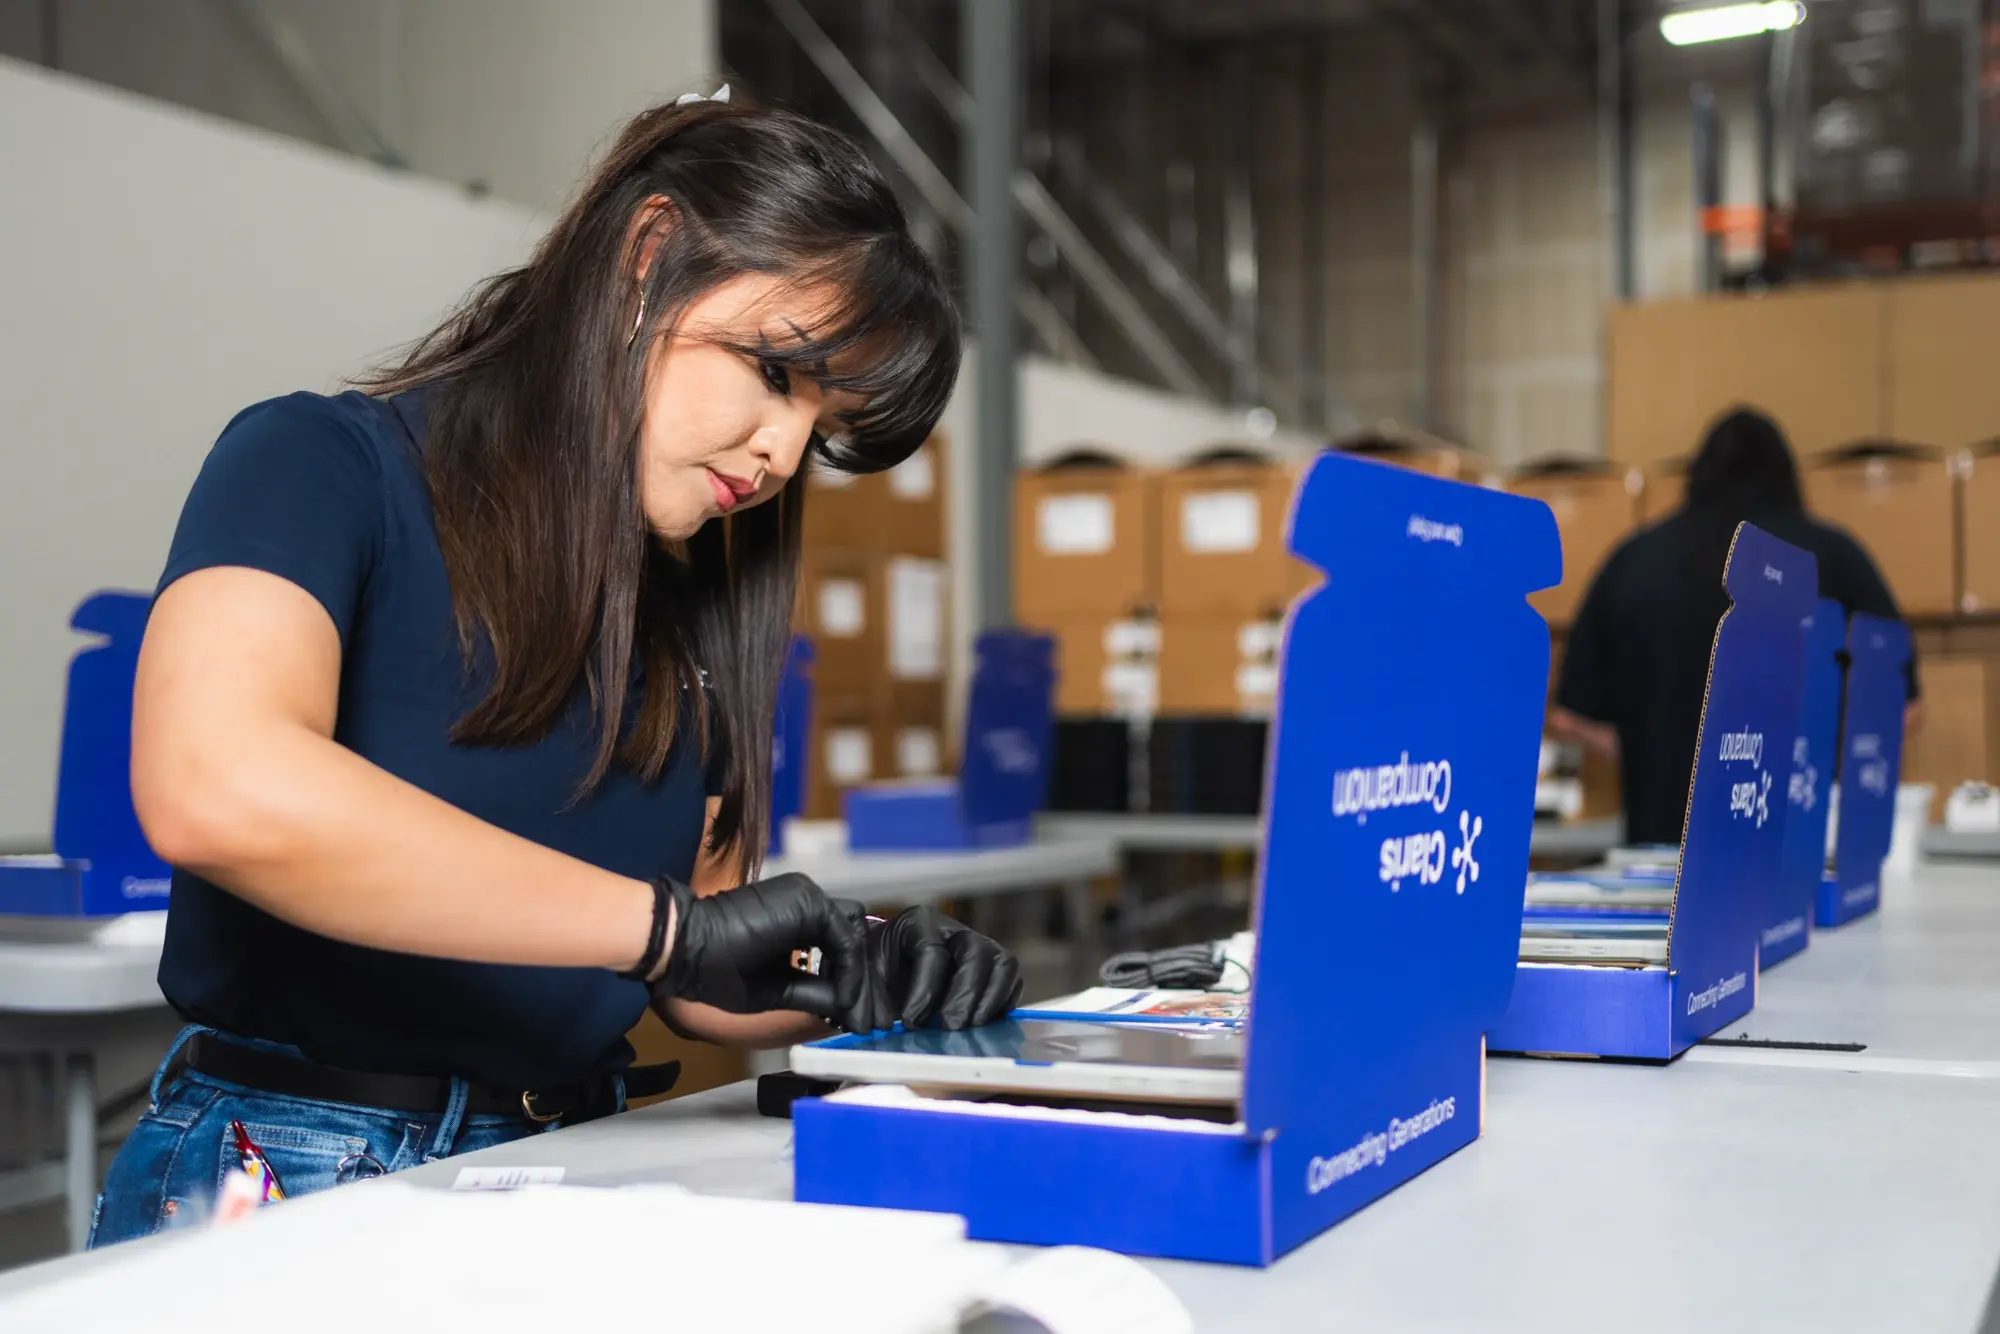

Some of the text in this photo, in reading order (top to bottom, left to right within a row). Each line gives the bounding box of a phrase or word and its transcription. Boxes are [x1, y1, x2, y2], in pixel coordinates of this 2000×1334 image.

[1719, 724, 1763, 770] Companion
[1332, 750, 1452, 826] Companion
[1730, 781, 1757, 820] Claris
[1379, 830, 1446, 893] Claris
[1306, 1096, 1455, 1195] Connecting Generations
